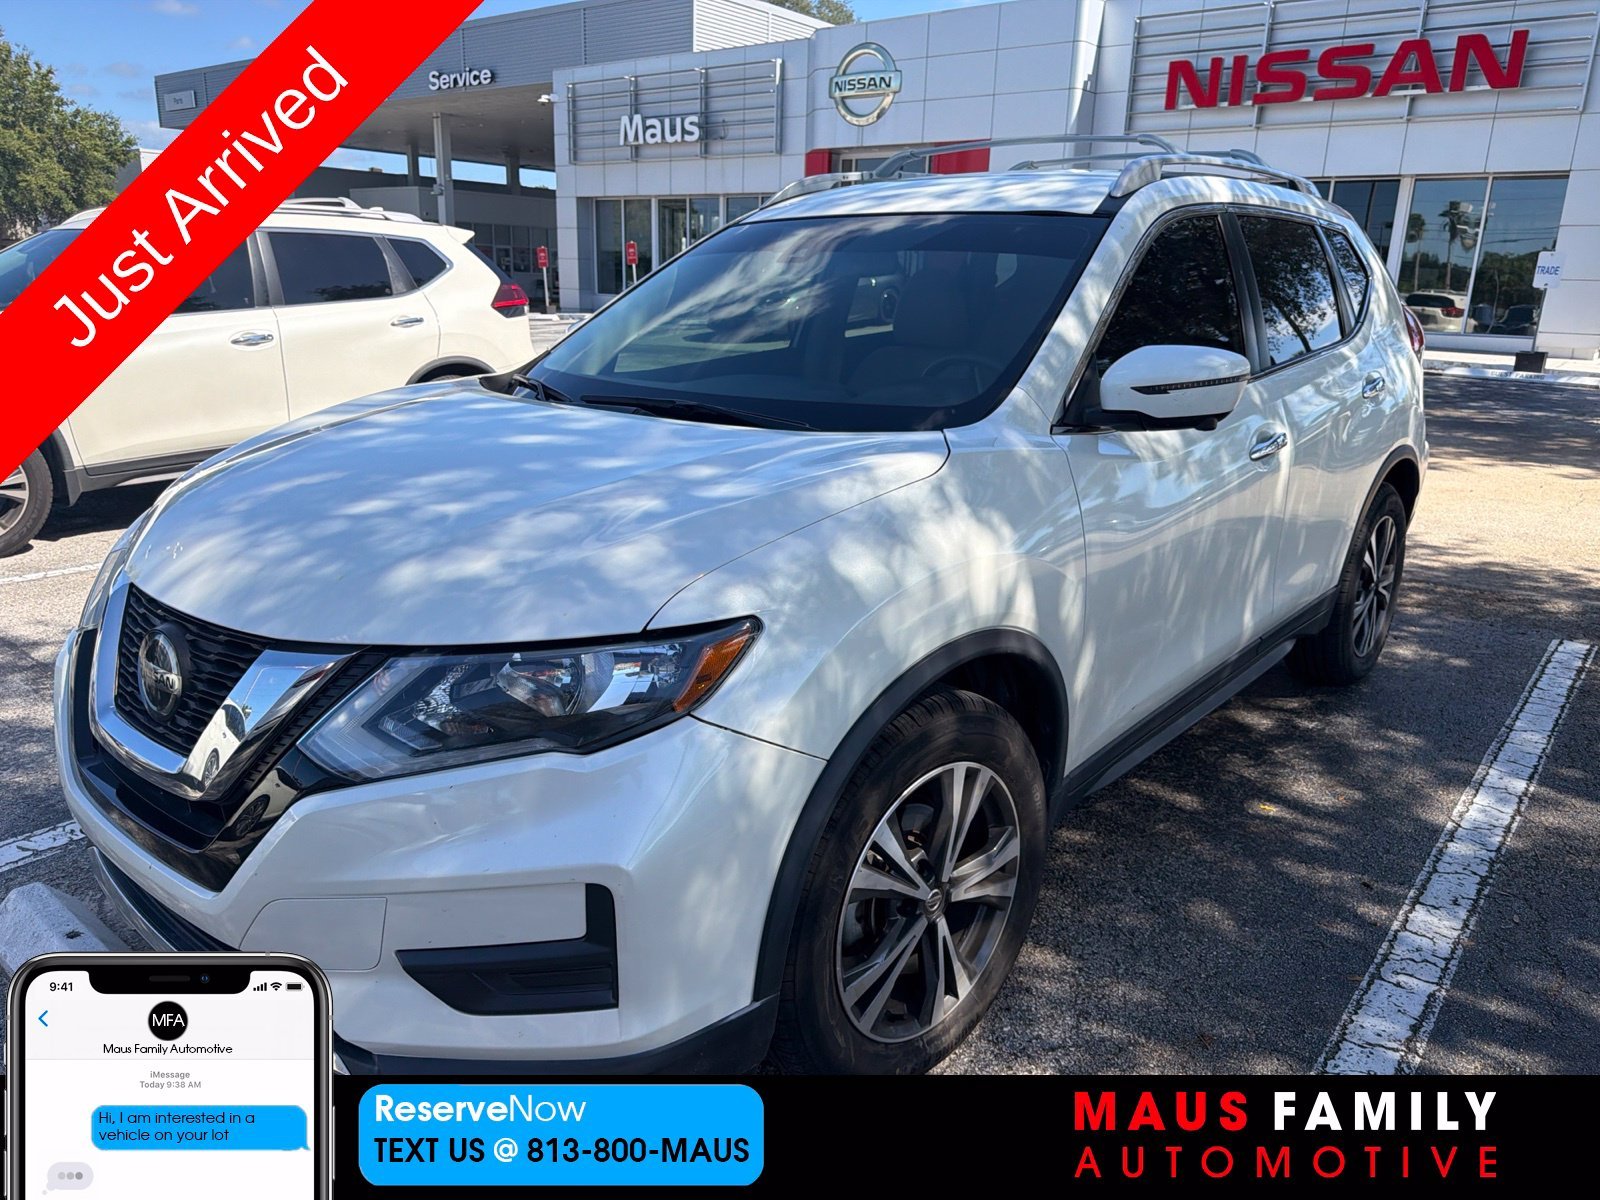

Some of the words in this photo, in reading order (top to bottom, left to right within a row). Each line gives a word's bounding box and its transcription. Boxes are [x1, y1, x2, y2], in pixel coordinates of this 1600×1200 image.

[428, 67, 492, 91] Service
[1165, 29, 1530, 110] NISSAN
[834, 75, 892, 93] NISSAN
[619, 113, 700, 146] Maus
[1536, 265, 1560, 276] TRADE
